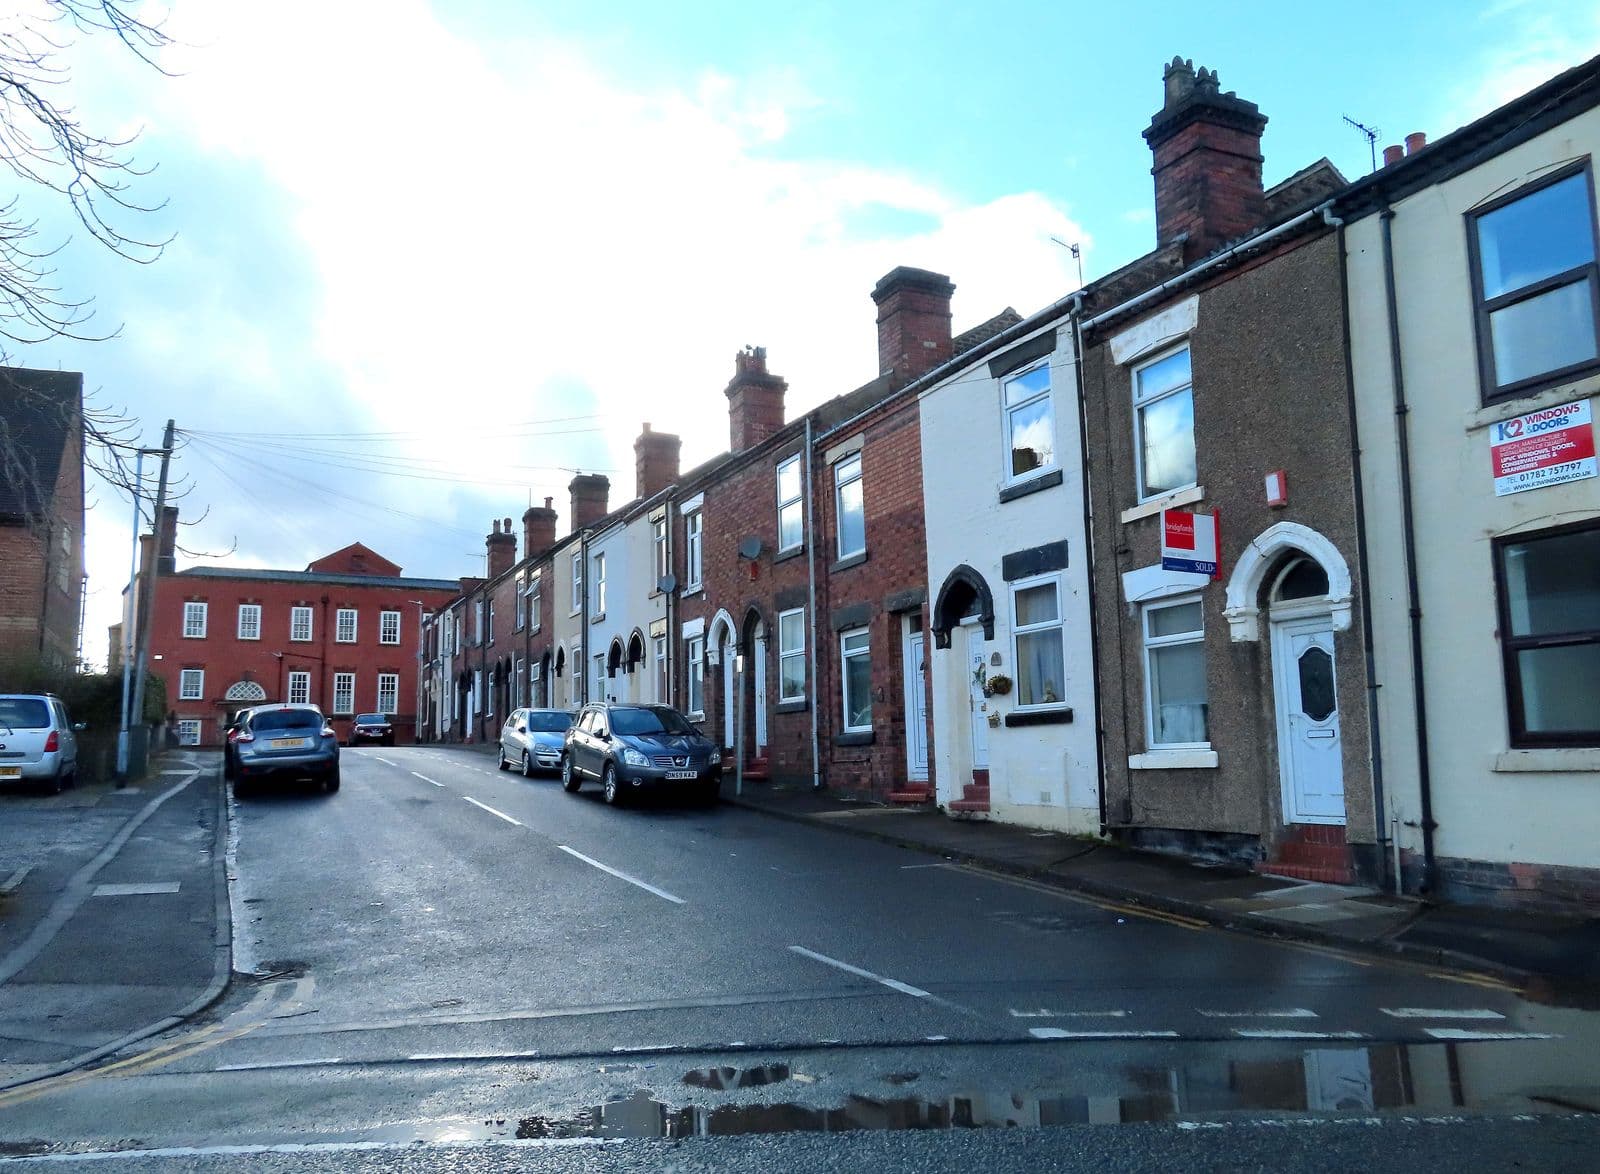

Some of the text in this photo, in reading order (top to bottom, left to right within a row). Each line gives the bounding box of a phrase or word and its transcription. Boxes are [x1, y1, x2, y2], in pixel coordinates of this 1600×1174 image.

[1524, 403, 1580, 424] WINDOWS
[1497, 419, 1524, 441] K2
[1519, 469, 1546, 482] 01782
[1549, 462, 1582, 476] 757797
[1195, 562, 1213, 572] SOLD
